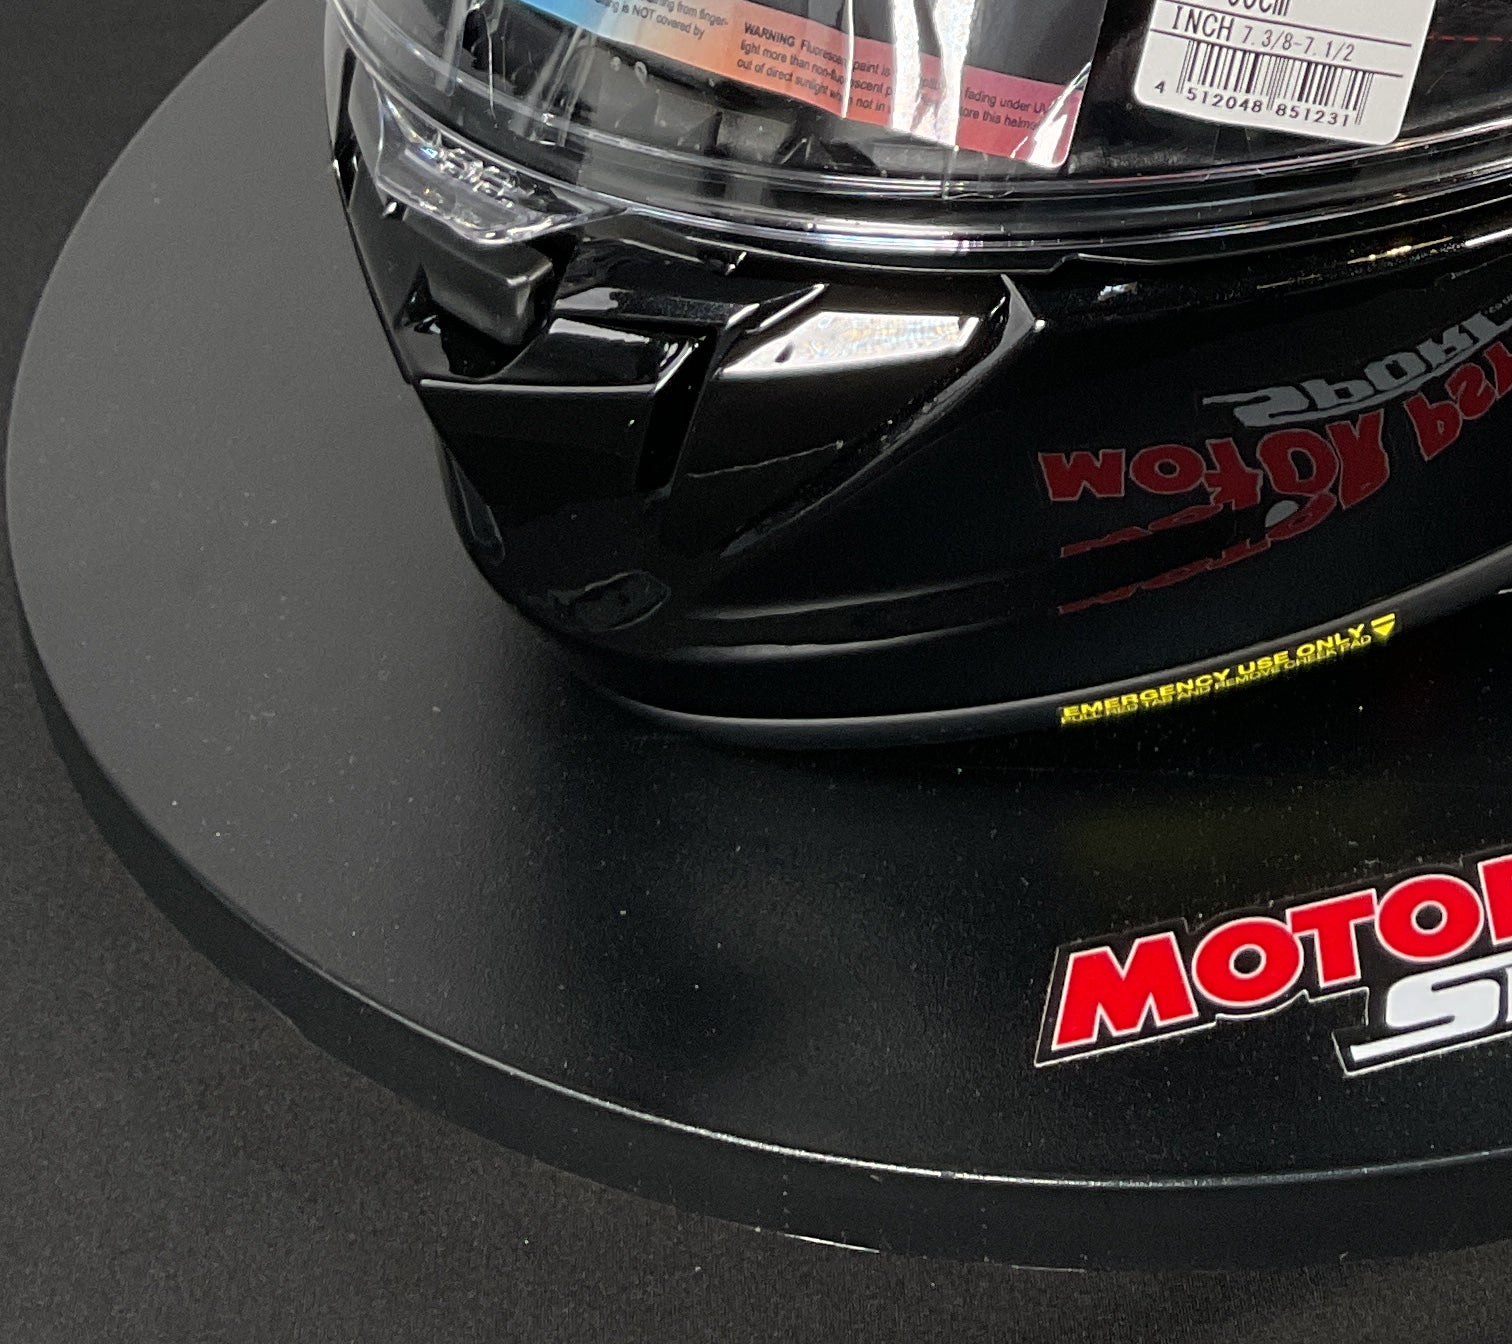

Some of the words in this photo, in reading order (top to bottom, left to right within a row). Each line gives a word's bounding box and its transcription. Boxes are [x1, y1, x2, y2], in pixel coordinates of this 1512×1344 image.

[633, 5, 656, 20] NOT
[656, 14, 691, 33] covered
[694, 24, 705, 39] by
[677, 1, 698, 18] from
[1171, 5, 1235, 43] INCH
[740, 39, 760, 55] light
[763, 48, 787, 63] more
[790, 53, 811, 70] than
[744, 21, 795, 47] WARNING
[800, 38, 850, 67] Fluorescen
[852, 60, 879, 76] paint
[964, 87, 997, 106] fading
[1000, 97, 1030, 112] under
[737, 58, 753, 70] out
[755, 62, 765, 74] of
[766, 65, 793, 81] direct
[795, 76, 828, 95] sunlight
[856, 96, 874, 109] not
[1154, 80, 1165, 94] 4
[1186, 87, 1263, 113] 512048
[1275, 102, 1350, 128] 851231
[1340, 635, 1372, 655] PAD
[1062, 668, 1230, 718] EMERGENCY
[1238, 650, 1289, 675] USE
[1296, 623, 1365, 656] ONLY
